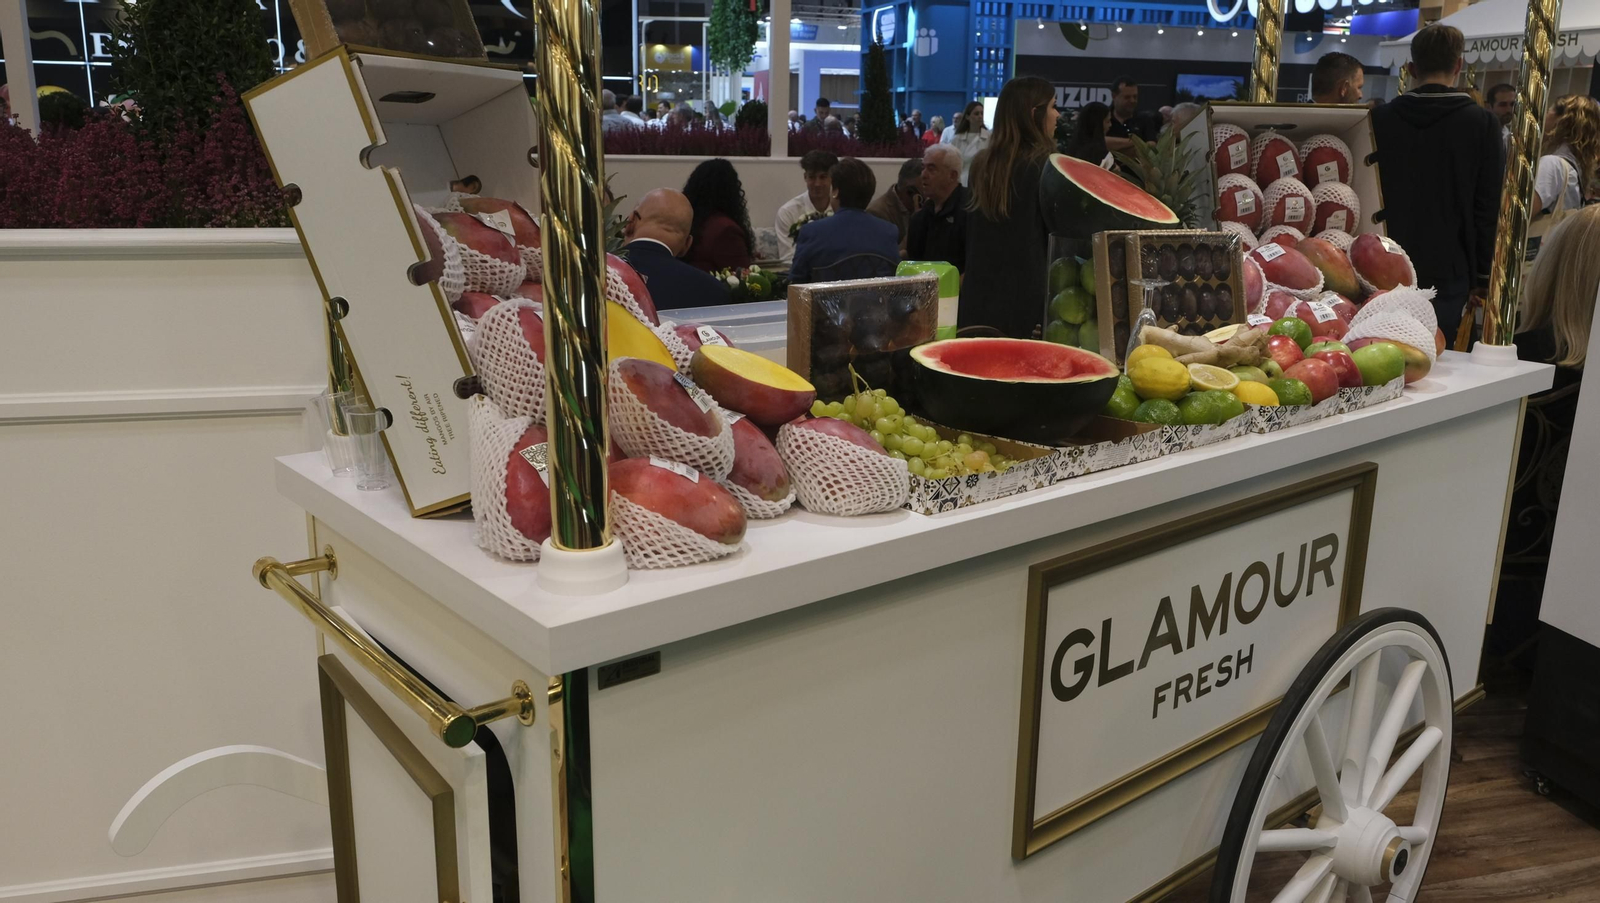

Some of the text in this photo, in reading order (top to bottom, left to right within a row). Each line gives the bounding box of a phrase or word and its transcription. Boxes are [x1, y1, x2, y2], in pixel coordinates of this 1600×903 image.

[1463, 37, 1518, 53] AMOUR
[395, 375, 446, 475] Eating different!
[423, 393, 448, 446] MANGOS BY AIR
[433, 392, 455, 440] TREE RIPENED
[1050, 532, 1340, 703] GLAMOUR
[1152, 643, 1255, 720] FRESH
